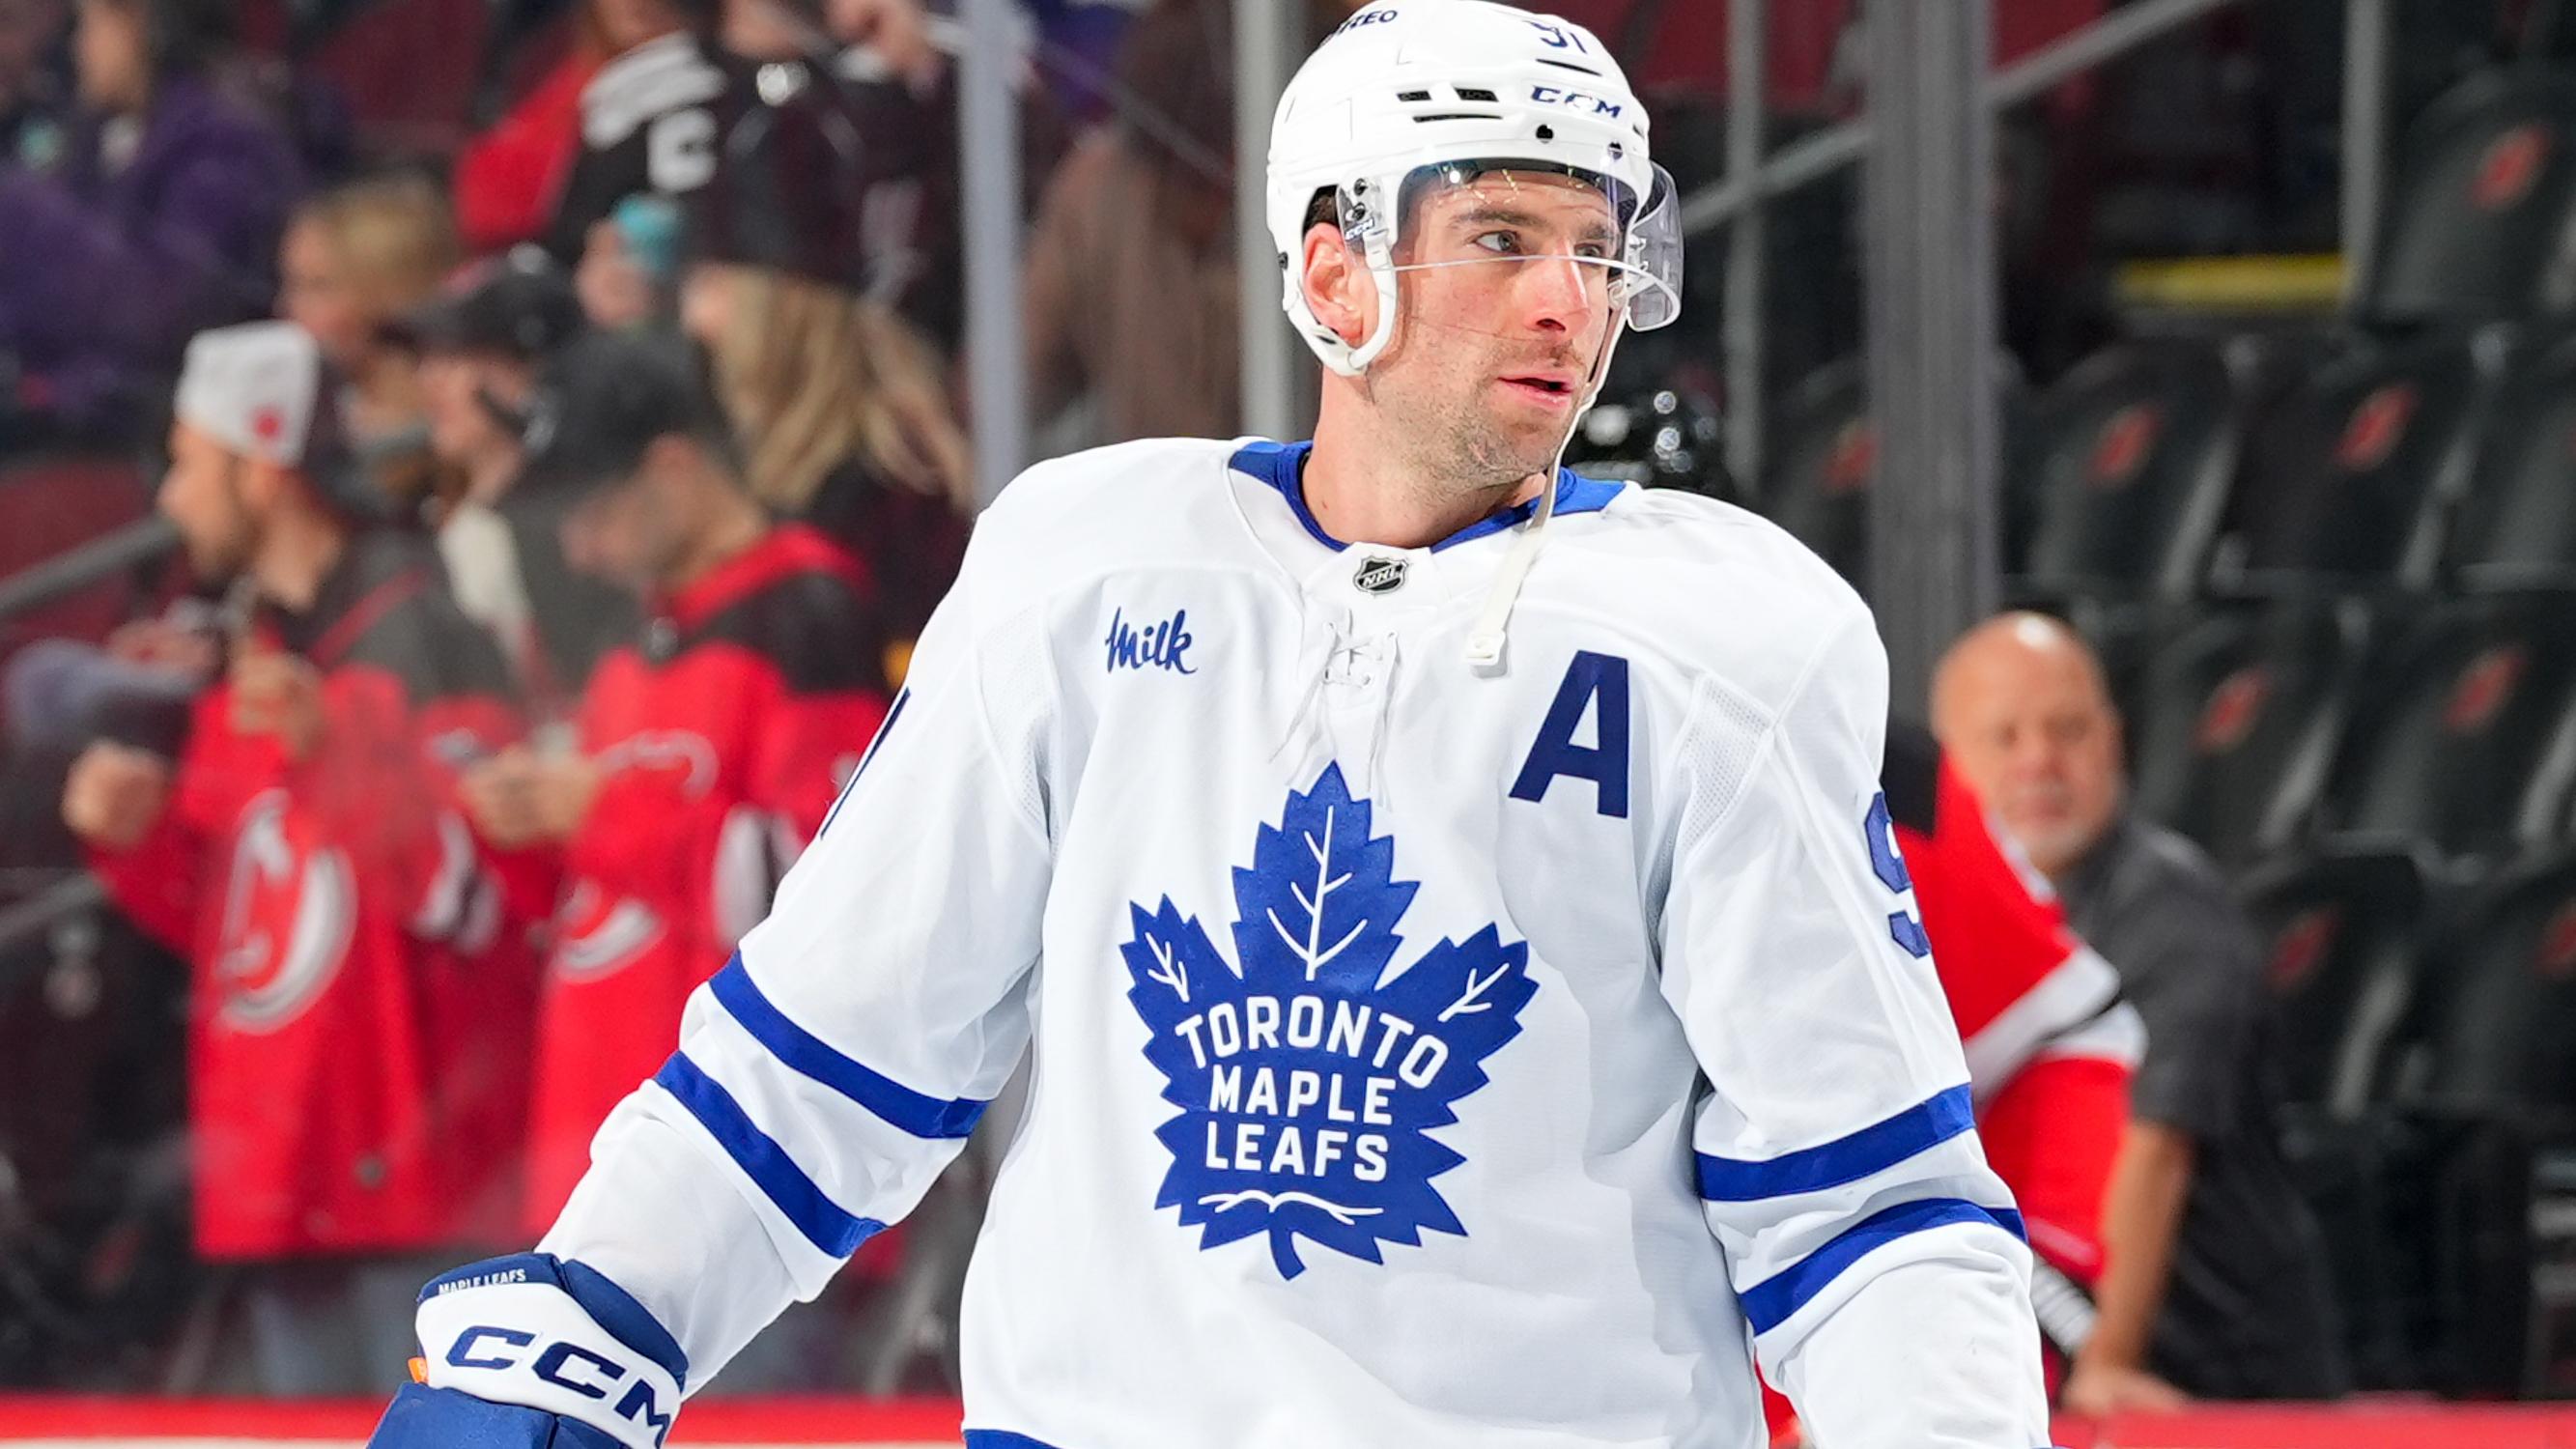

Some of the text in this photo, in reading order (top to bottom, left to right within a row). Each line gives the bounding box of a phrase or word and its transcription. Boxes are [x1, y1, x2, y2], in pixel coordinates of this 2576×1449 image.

[1531, 85, 1622, 118] CCM
[1362, 565, 1401, 588] NHL
[1105, 607, 1198, 675] Milk
[1509, 649, 1629, 819] A
[1175, 995, 1449, 1090] TORONTO
[1208, 1065, 1396, 1125] MAPLE
[1204, 1121, 1390, 1182] LEAFS
[484, 1268, 526, 1288] LEAFS
[445, 1324, 671, 1449] CCM
